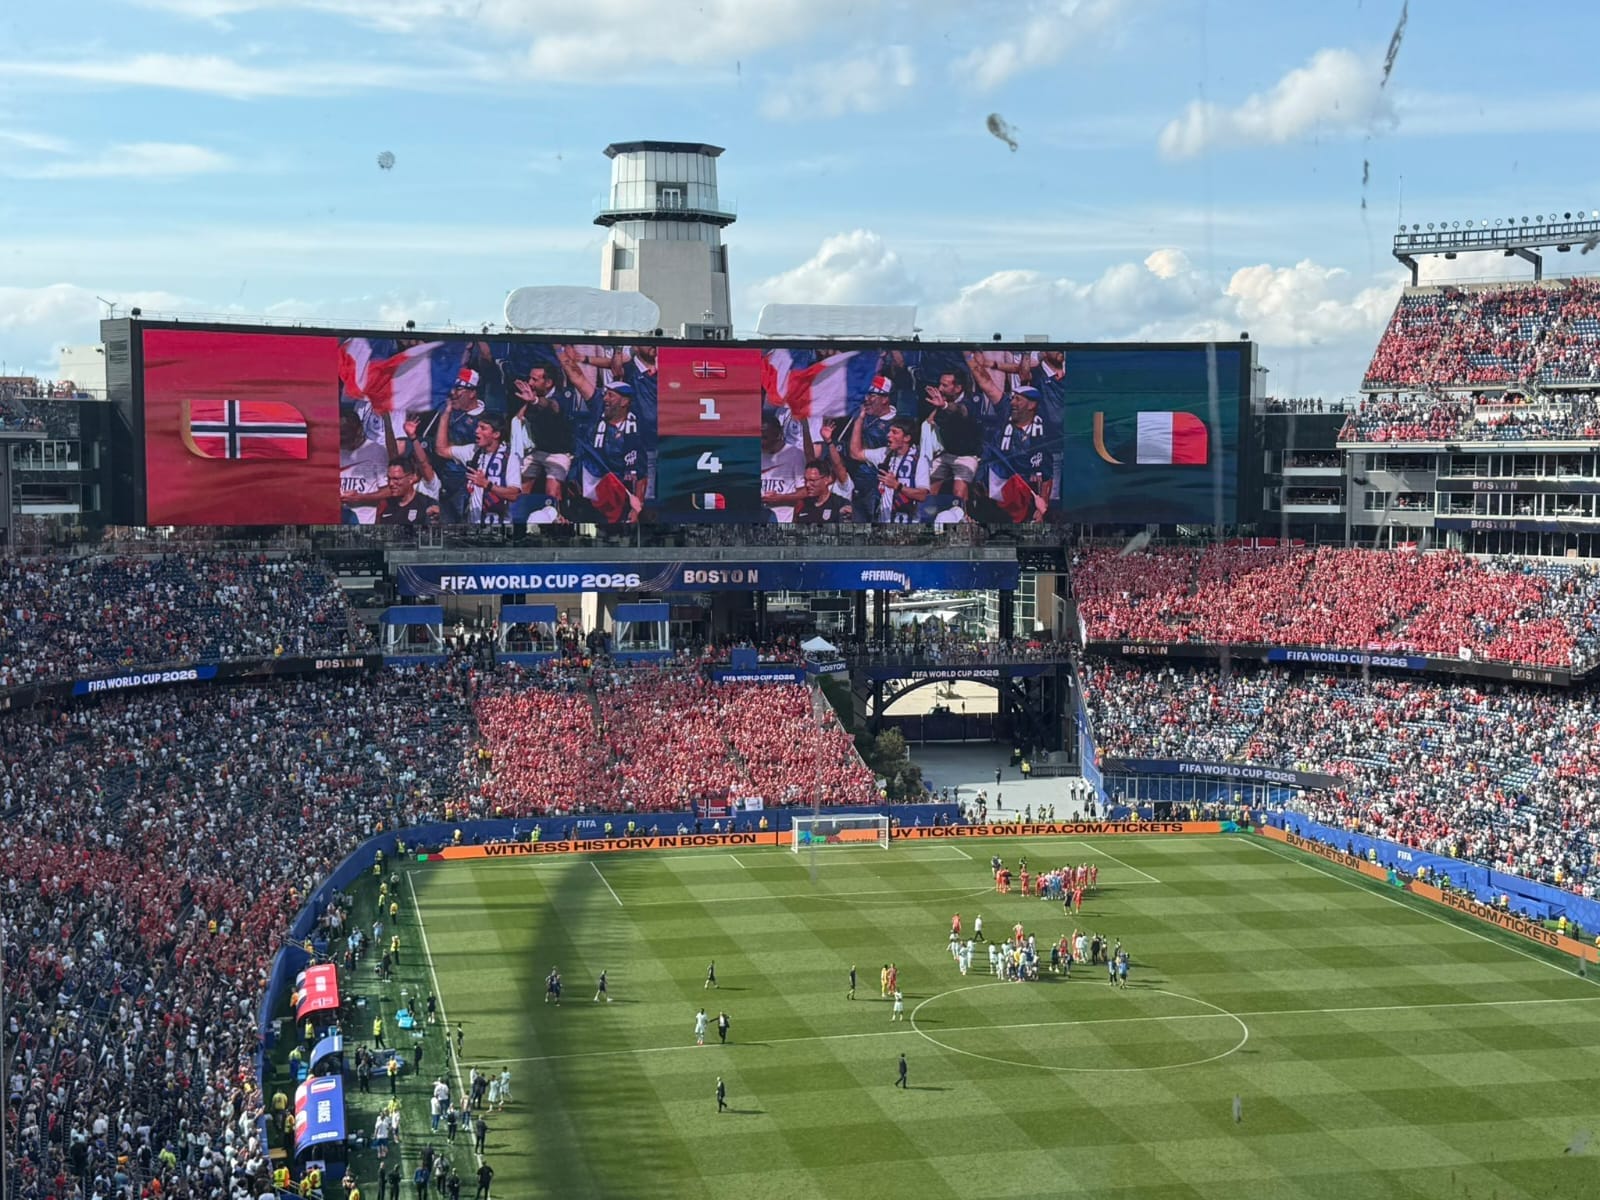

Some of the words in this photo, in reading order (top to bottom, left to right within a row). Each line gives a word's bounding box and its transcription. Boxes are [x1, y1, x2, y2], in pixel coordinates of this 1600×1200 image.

[699, 398, 721, 420] 1
[696, 451, 723, 473] 4
[440, 576, 478, 590] FIFA
[480, 575, 542, 589] WORLD
[545, 574, 579, 588] CUP
[581, 573, 640, 588] 2026
[683, 569, 758, 584] BOSTON
[1122, 645, 1168, 654] BOSTON
[315, 658, 364, 669] BOSTON
[820, 663, 846, 672] BOSTON
[1286, 651, 1308, 660] FIFA
[1310, 652, 1348, 663] WORLD
[1350, 654, 1370, 664] CUP
[1372, 656, 1408, 667] 2026
[88, 678, 107, 692] FIFA
[108, 676, 141, 689] WORLD
[142, 674, 161, 685] CUP
[162, 670, 198, 682] 2026
[1512, 668, 1552, 682] BOSTON
[1180, 763, 1201, 774] FIFA
[1203, 765, 1240, 776] WORLD
[1242, 768, 1263, 778] CUP
[1264, 770, 1296, 782] 2026
[576, 820, 596, 828] FIFA
[877, 828, 912, 839] BUY
[918, 826, 989, 838] TICKETS
[992, 824, 1018, 836] ON
[1021, 822, 1183, 834] FIFA.COM/TICKETS
[484, 842, 570, 856] WITNESS
[574, 838, 655, 851] HISTORY
[659, 838, 676, 848] IN
[681, 834, 756, 846] BOSTON
[1286, 833, 1305, 850] BUY
[1305, 840, 1344, 864] TICKETS
[1344, 856, 1360, 870] ON
[1398, 850, 1412, 862] FIFA
[1441, 892, 1559, 946] FIFA.COM/TICKETS
